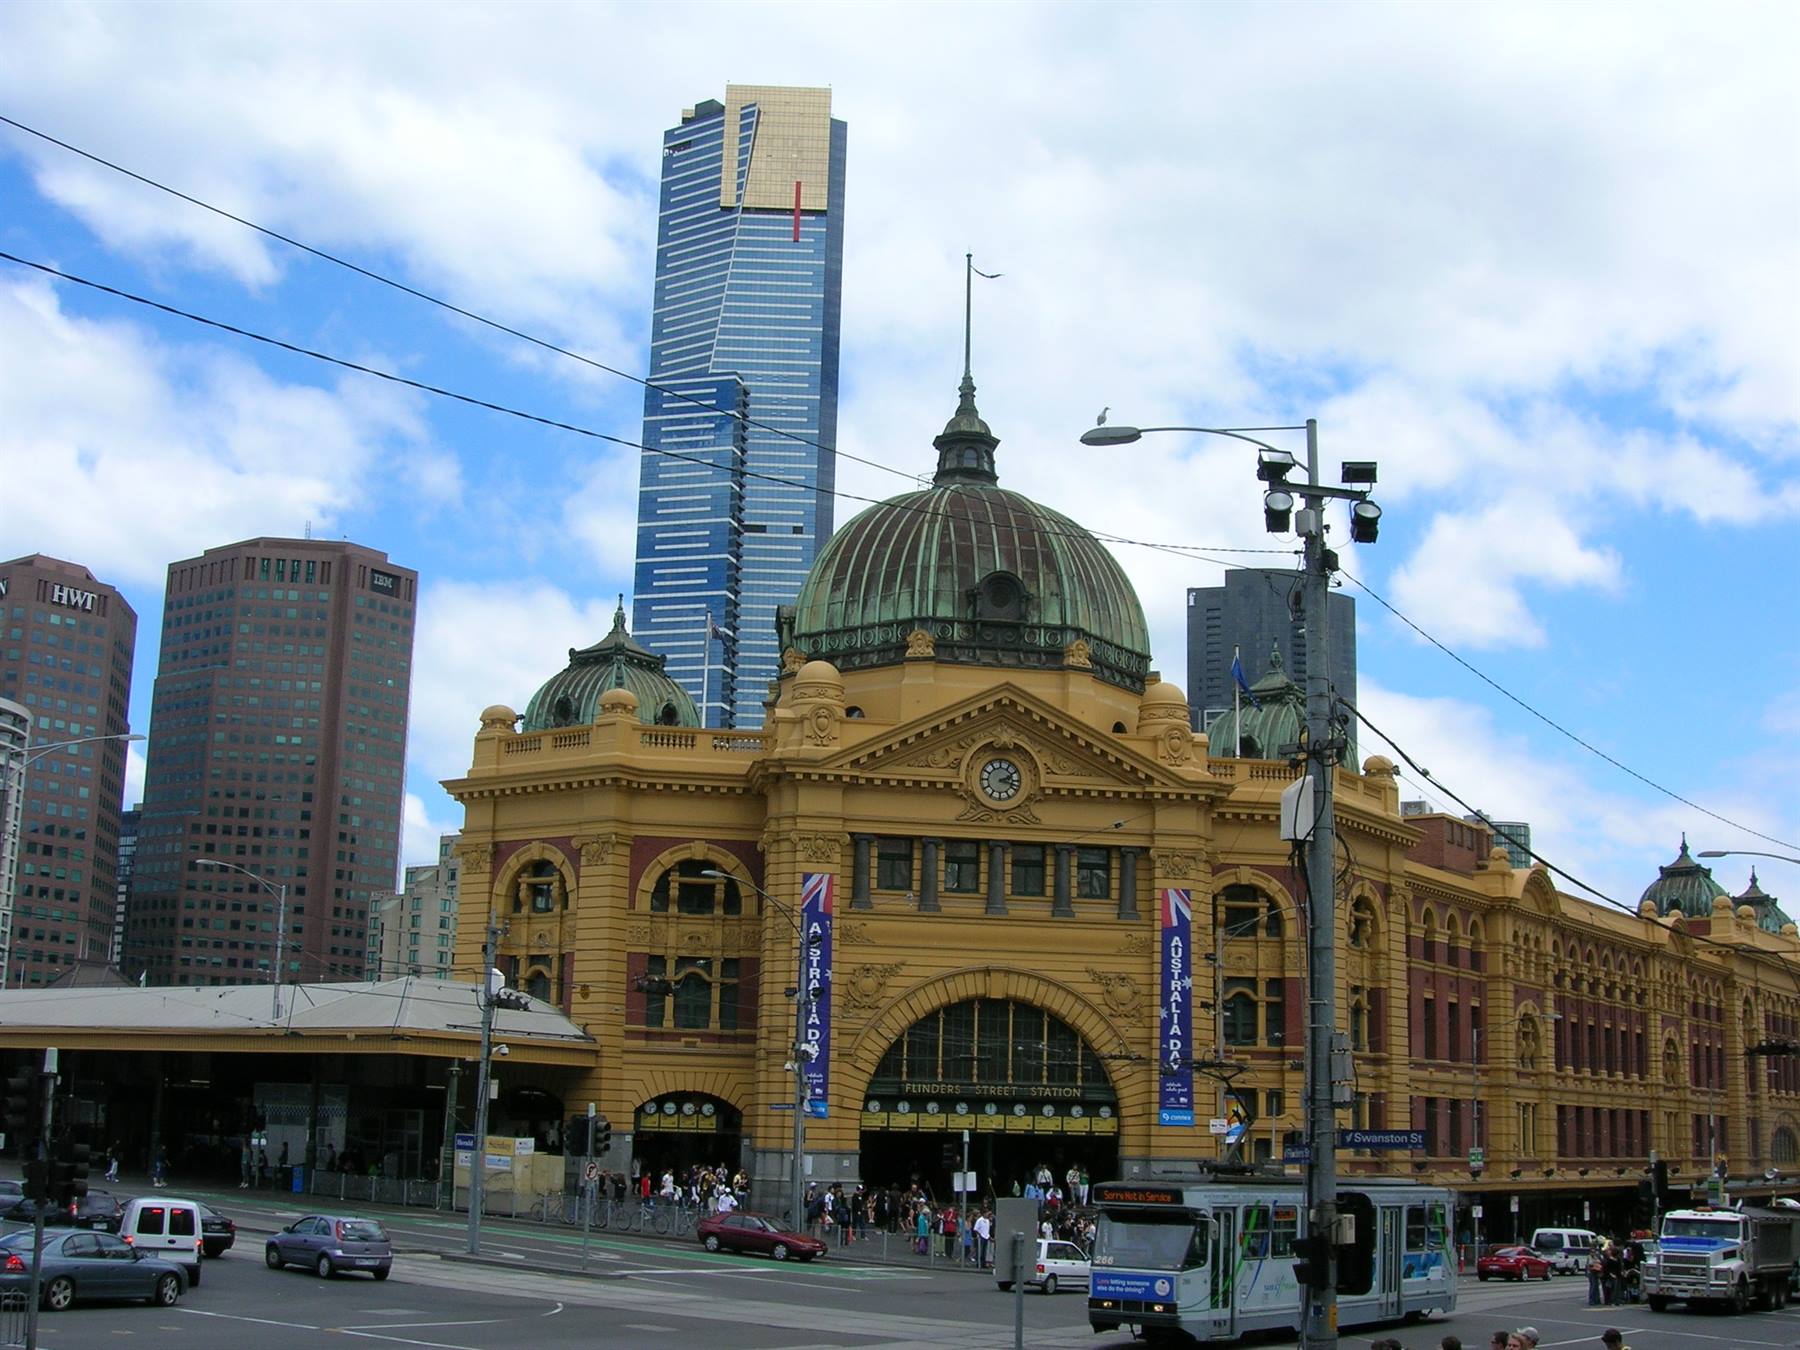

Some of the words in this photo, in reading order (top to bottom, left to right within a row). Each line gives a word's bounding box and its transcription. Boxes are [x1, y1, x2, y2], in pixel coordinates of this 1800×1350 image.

[373, 573, 393, 589] IBM
[52, 584, 97, 610] HWT
[1169, 936, 1183, 1036] AUSTRALIA
[905, 1083, 961, 1095] FLINDERS
[975, 1085, 1018, 1096] STREET
[1031, 1086, 1081, 1098] STATION
[1354, 1132, 1408, 1143] Swanston
[1410, 1132, 1422, 1143] St
[1124, 1191, 1137, 1200] Not
[1145, 1191, 1171, 1202] Service
